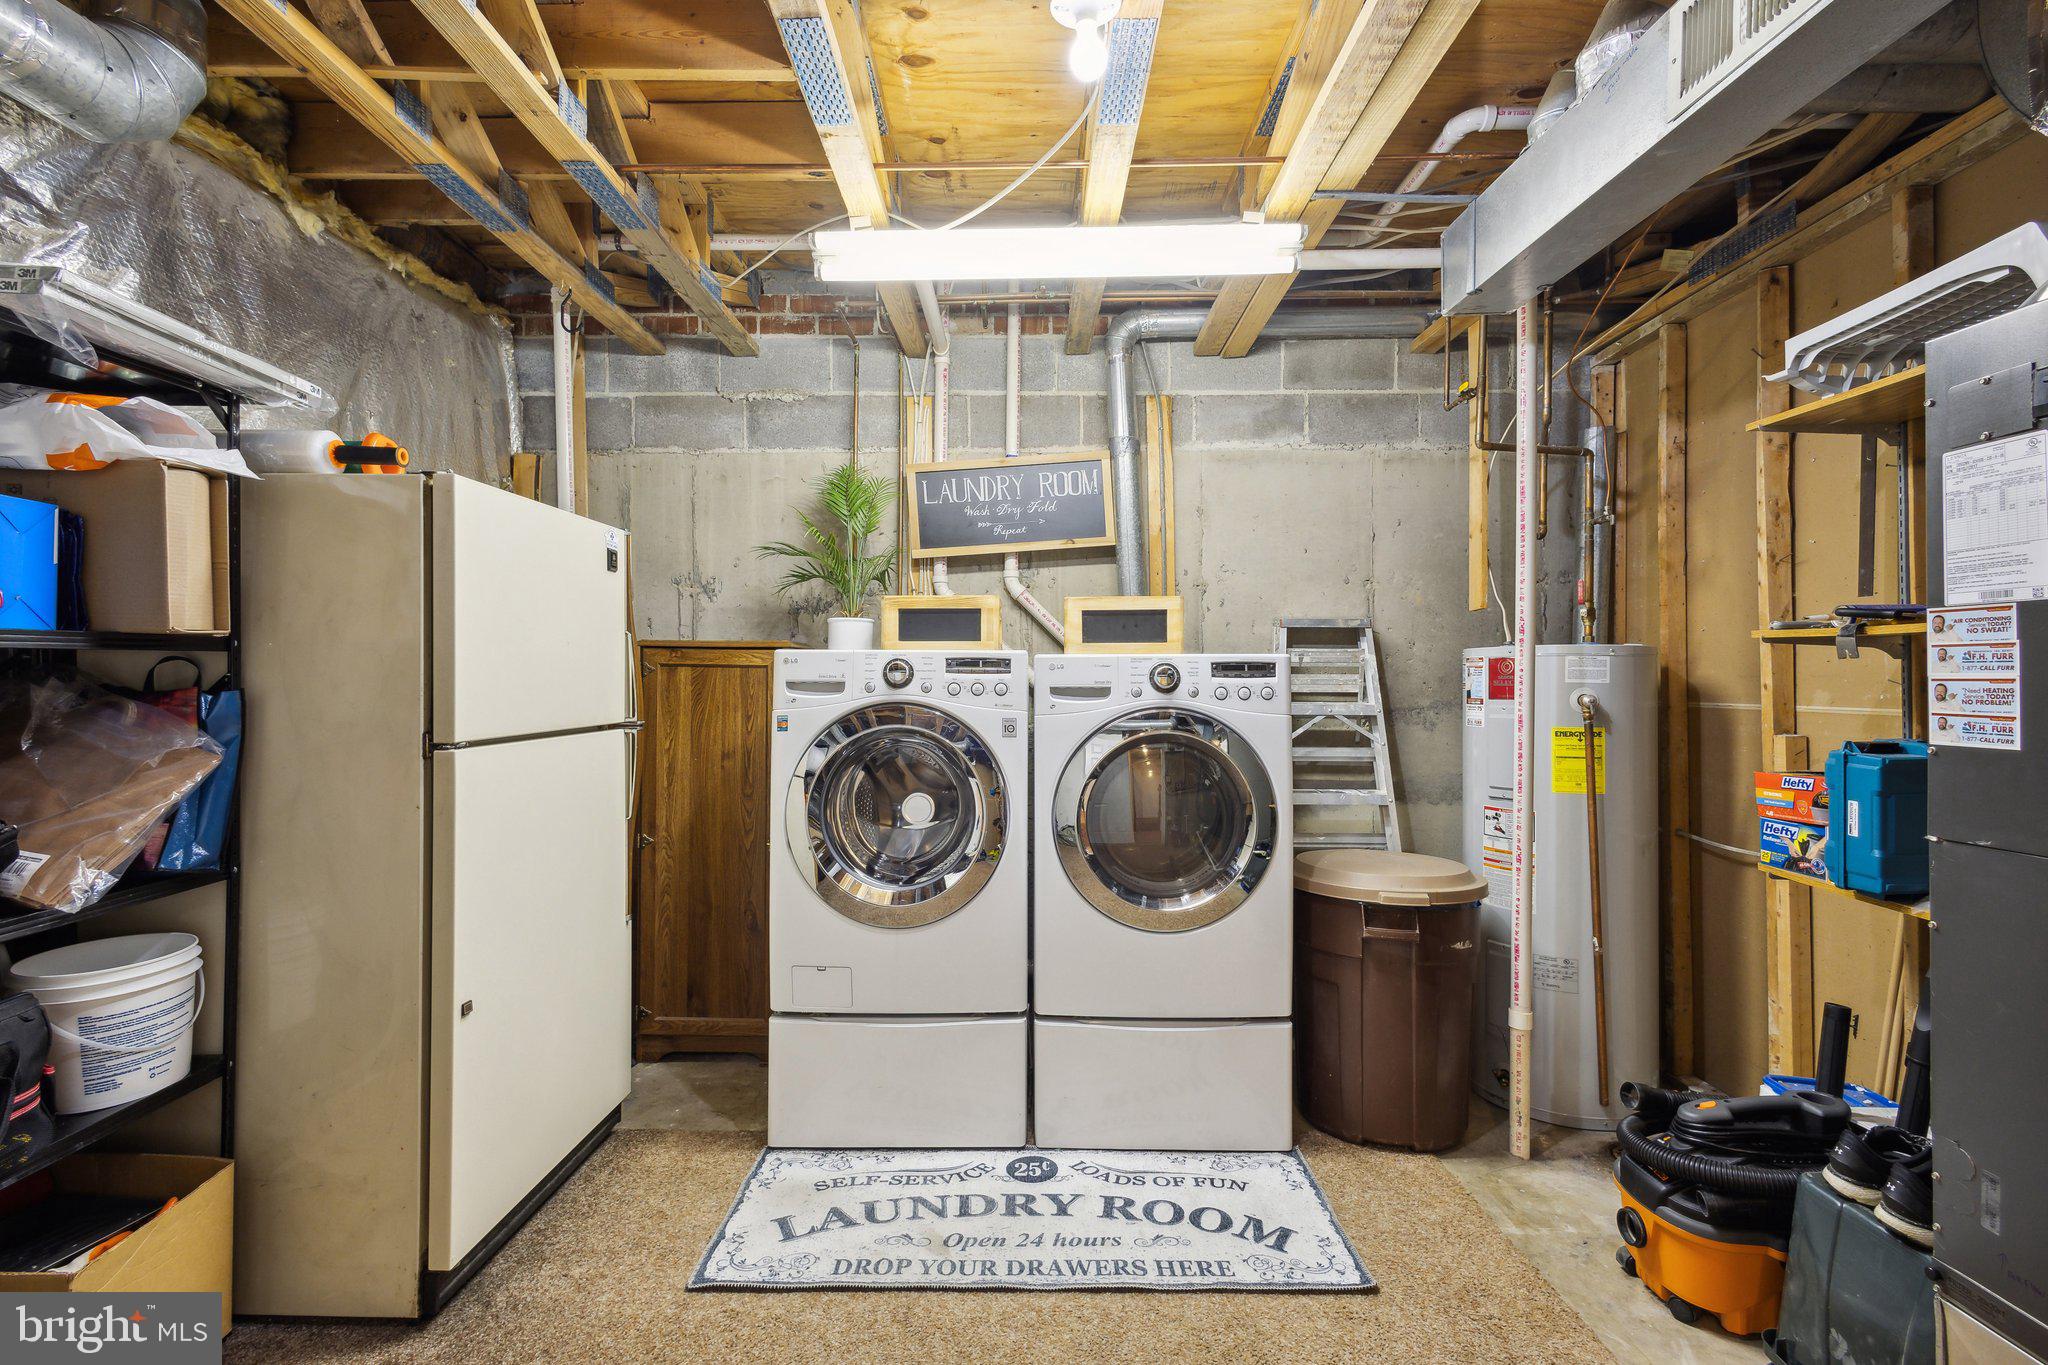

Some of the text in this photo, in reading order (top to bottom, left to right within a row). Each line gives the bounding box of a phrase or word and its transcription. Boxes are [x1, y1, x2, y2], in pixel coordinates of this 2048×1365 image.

[17, 268, 37, 278] 3M
[0, 281, 18, 291] 3M
[921, 469, 1099, 505] LAUNDRY ROOM
[964, 500, 1058, 520] Wash Dry Fold
[993, 524, 1028, 540] Repeat
[1965, 615, 2012, 623] CONDITIONING
[1992, 652, 2014, 660] FURR
[1992, 725, 2014, 734] FURR
[1997, 737, 2015, 745] FURR
[1782, 777, 1813, 791] Hefty
[1764, 822, 1798, 840] Hefty
[1762, 851, 1770, 859] 25
[814, 1159, 1250, 1192] SELF-SERVICE LOADS OF FUN
[1013, 1159, 1050, 1178] 25¢
[770, 1192, 1299, 1253] LAUNDRY ROOM
[943, 1232, 1122, 1251] Open 24 hours
[831, 1258, 1237, 1278] DROP YOUR DRAWERS HERE
